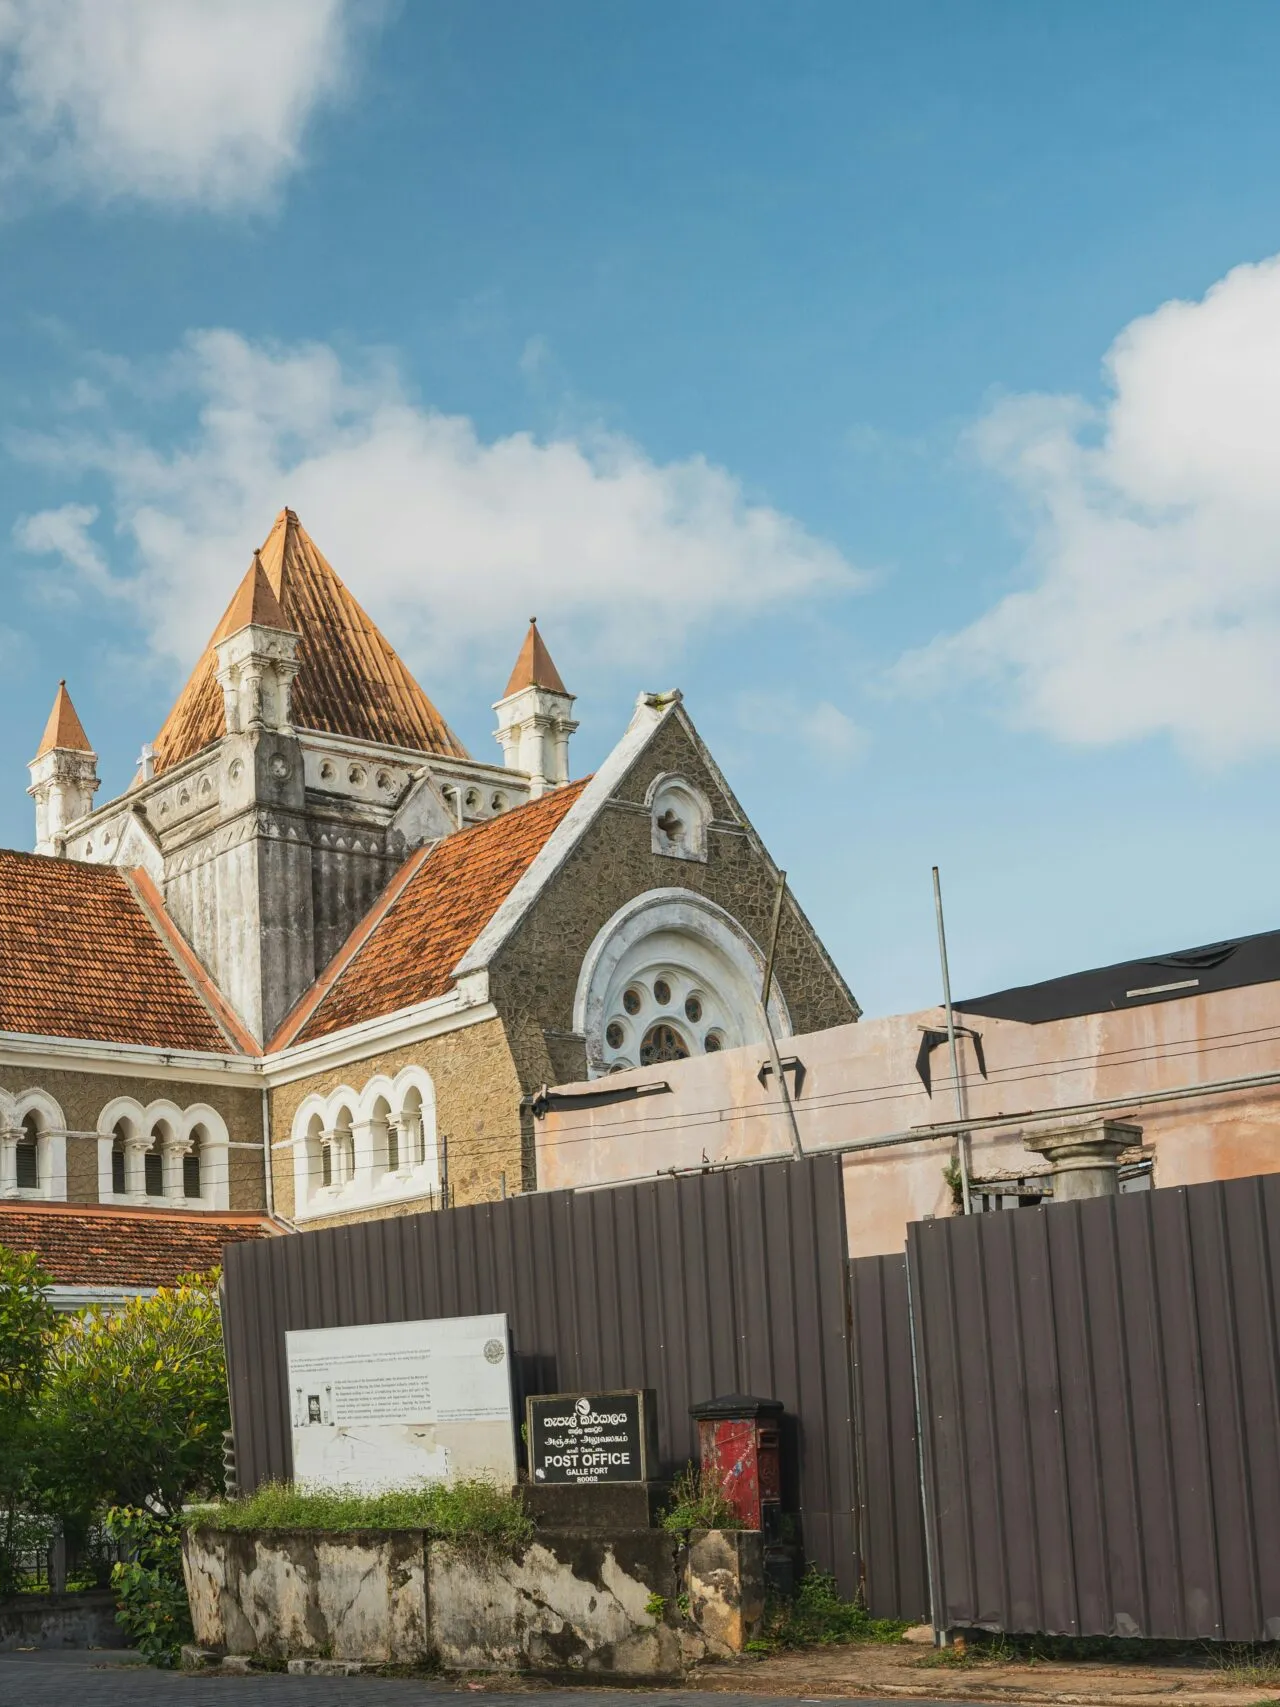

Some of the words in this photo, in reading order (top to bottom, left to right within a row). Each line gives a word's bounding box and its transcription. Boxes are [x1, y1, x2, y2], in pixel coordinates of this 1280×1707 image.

[544, 1413, 577, 1427] තැපැල්
[580, 1412, 627, 1425] කාර්යාලය
[544, 1434, 577, 1448] அஞ்சல்
[580, 1432, 628, 1445] அலுவலகம்
[544, 1454, 579, 1468] POST
[582, 1452, 631, 1466] OFFICE
[589, 1467, 608, 1475] FORT
